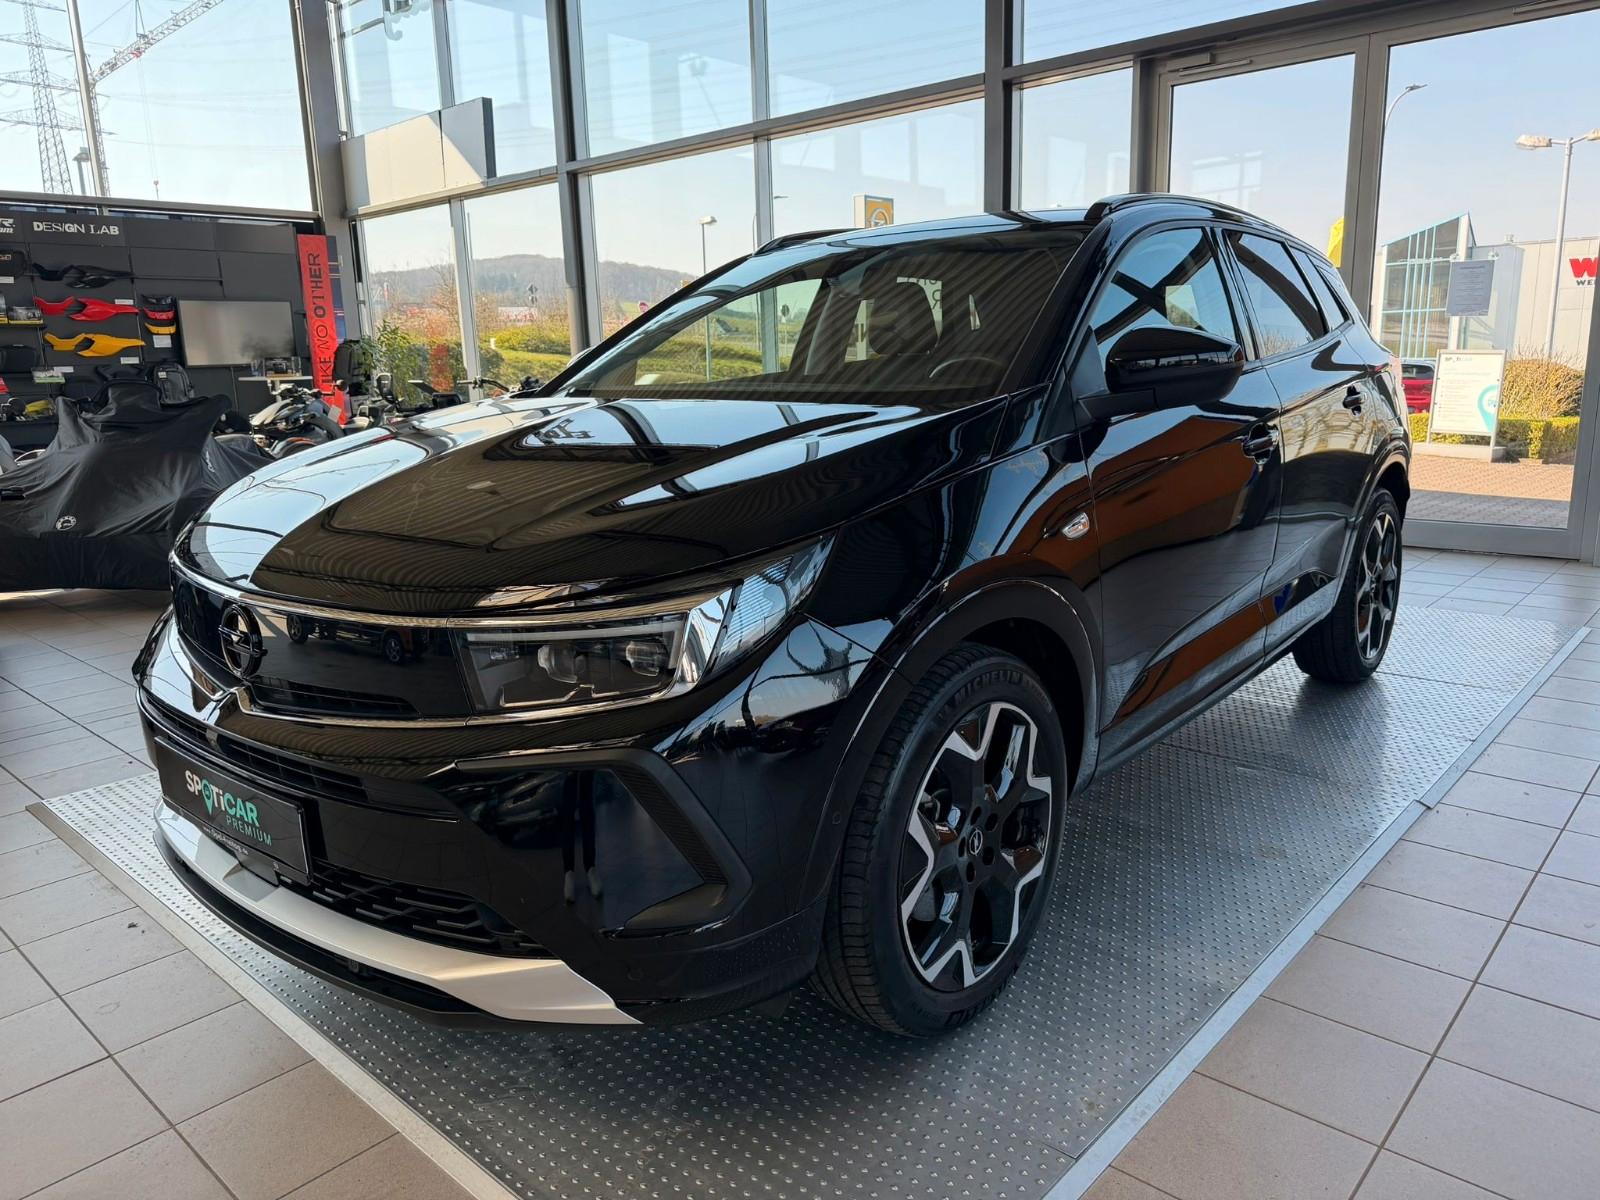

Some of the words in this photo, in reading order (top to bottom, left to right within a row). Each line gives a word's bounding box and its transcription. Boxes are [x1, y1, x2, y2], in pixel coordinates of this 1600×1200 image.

[33, 221, 86, 234] DESIGN
[89, 224, 120, 235] LAB
[307, 252, 326, 319] OTHER
[316, 324, 330, 351] NO
[953, 670, 1025, 707] MICHELIN
[226, 814, 272, 847] PREMIUM
